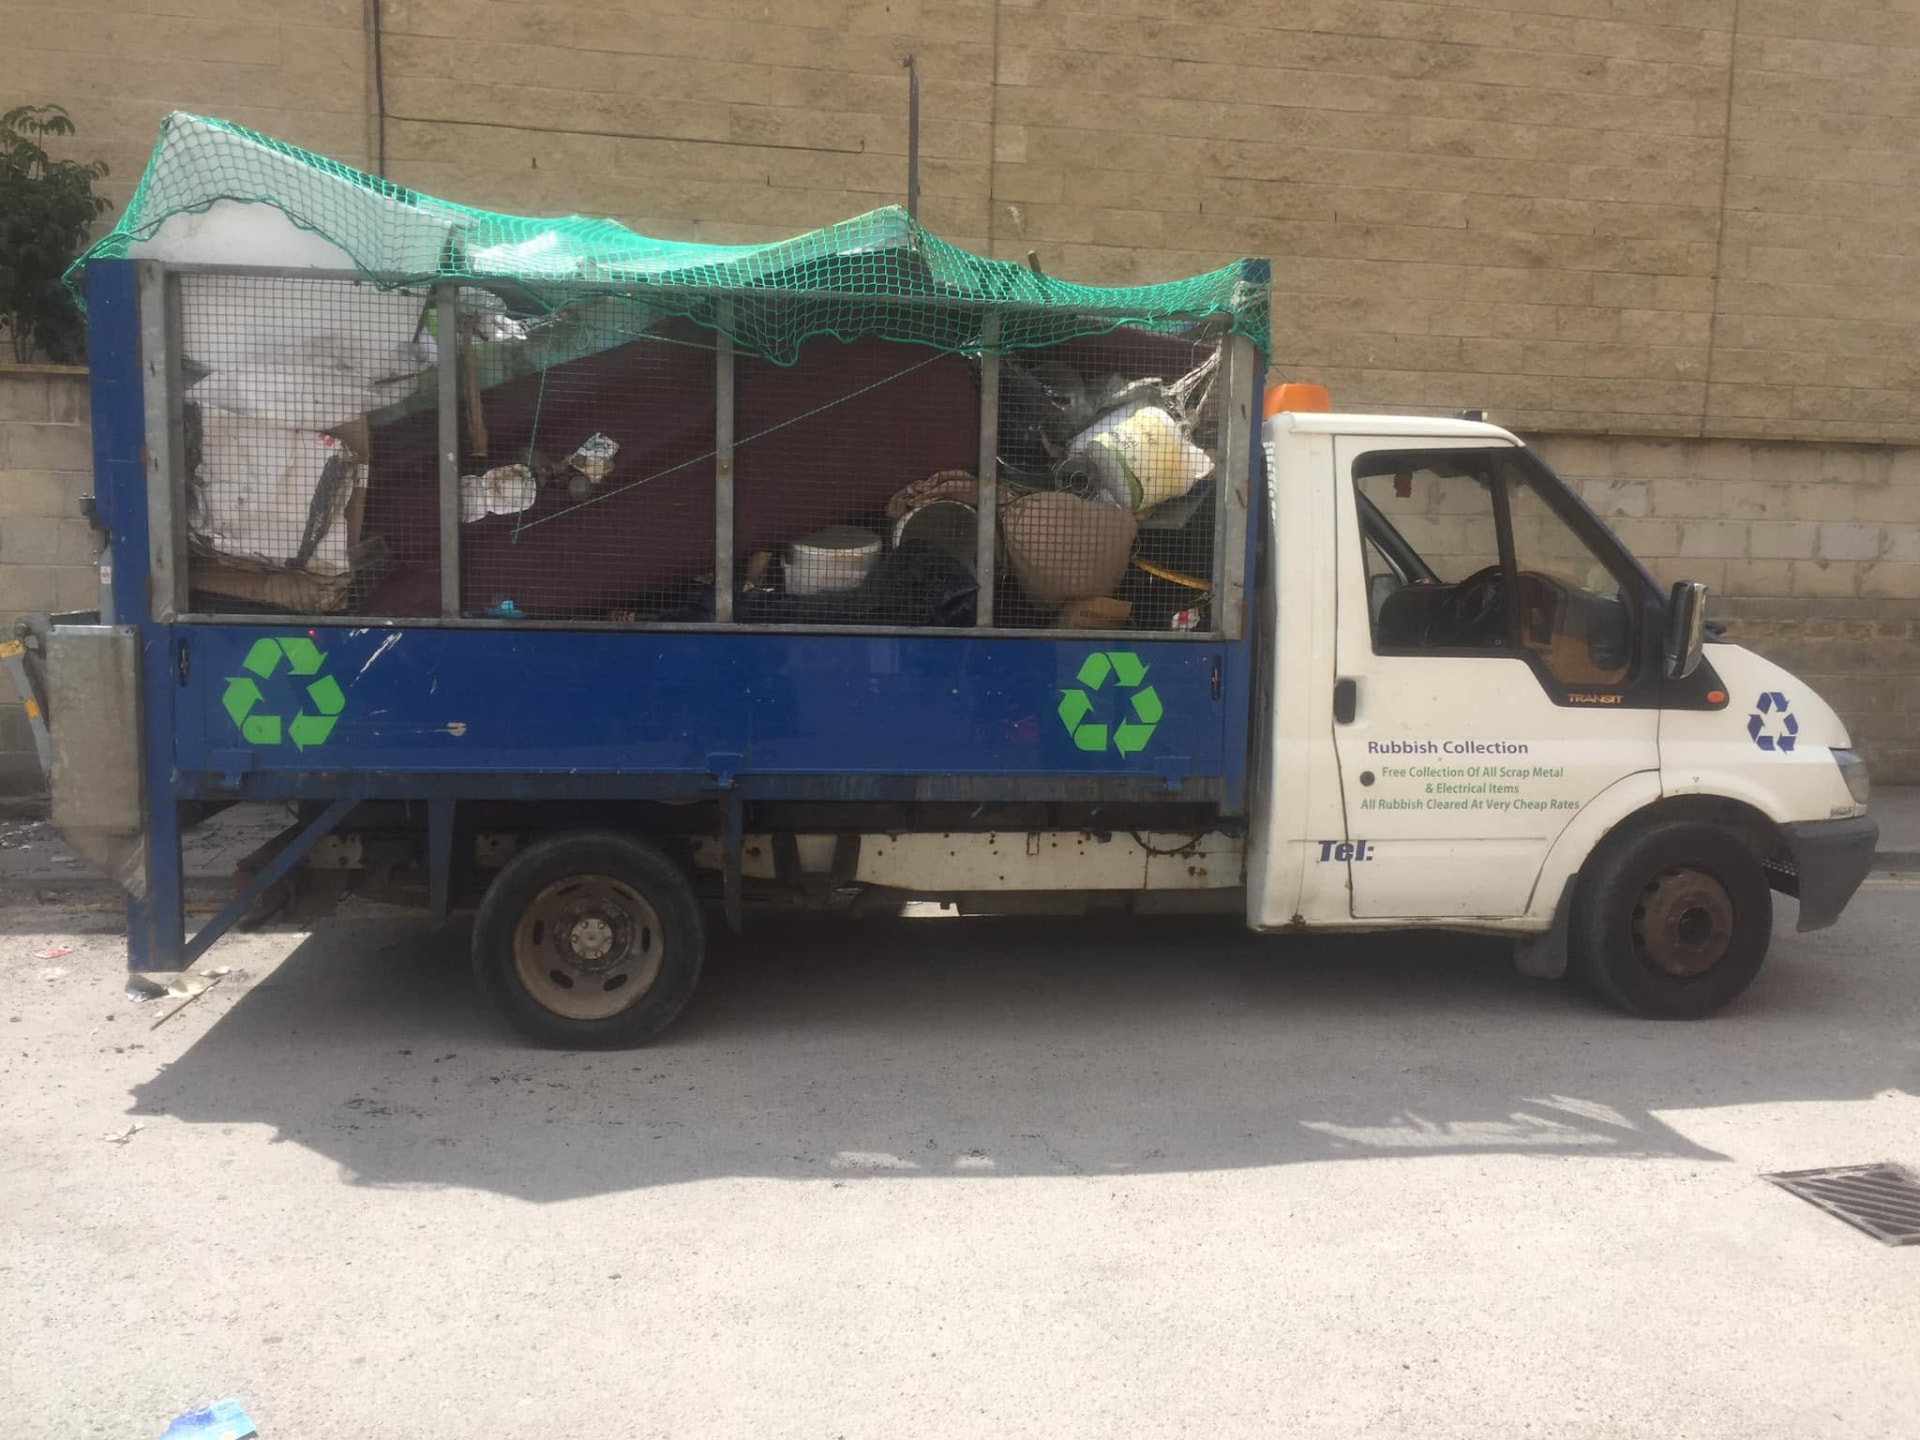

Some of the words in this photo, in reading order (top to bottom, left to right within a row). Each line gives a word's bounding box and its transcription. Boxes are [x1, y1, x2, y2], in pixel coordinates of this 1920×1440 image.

[1568, 693, 1623, 704] TRANSIT
[1368, 741, 1438, 754] Rubbish
[1443, 741, 1528, 754] Collection
[1382, 766, 1406, 777] Free
[1409, 766, 1464, 777] Collection
[1467, 766, 1480, 777] Of
[1482, 766, 1497, 778] All
[1500, 767, 1529, 780] Scrap
[1532, 767, 1563, 778] Metal
[1425, 783, 1434, 793] &
[1437, 783, 1486, 793] Electrical
[1489, 783, 1519, 793] Items
[1361, 799, 1376, 809] All
[1378, 799, 1423, 809] Rubbish
[1426, 799, 1468, 810] Cleared
[1471, 799, 1484, 809] At
[1486, 799, 1511, 812] Very
[1513, 799, 1547, 811] Cheap
[1550, 799, 1580, 810] Rates
[1318, 840, 1374, 862] Tel:
